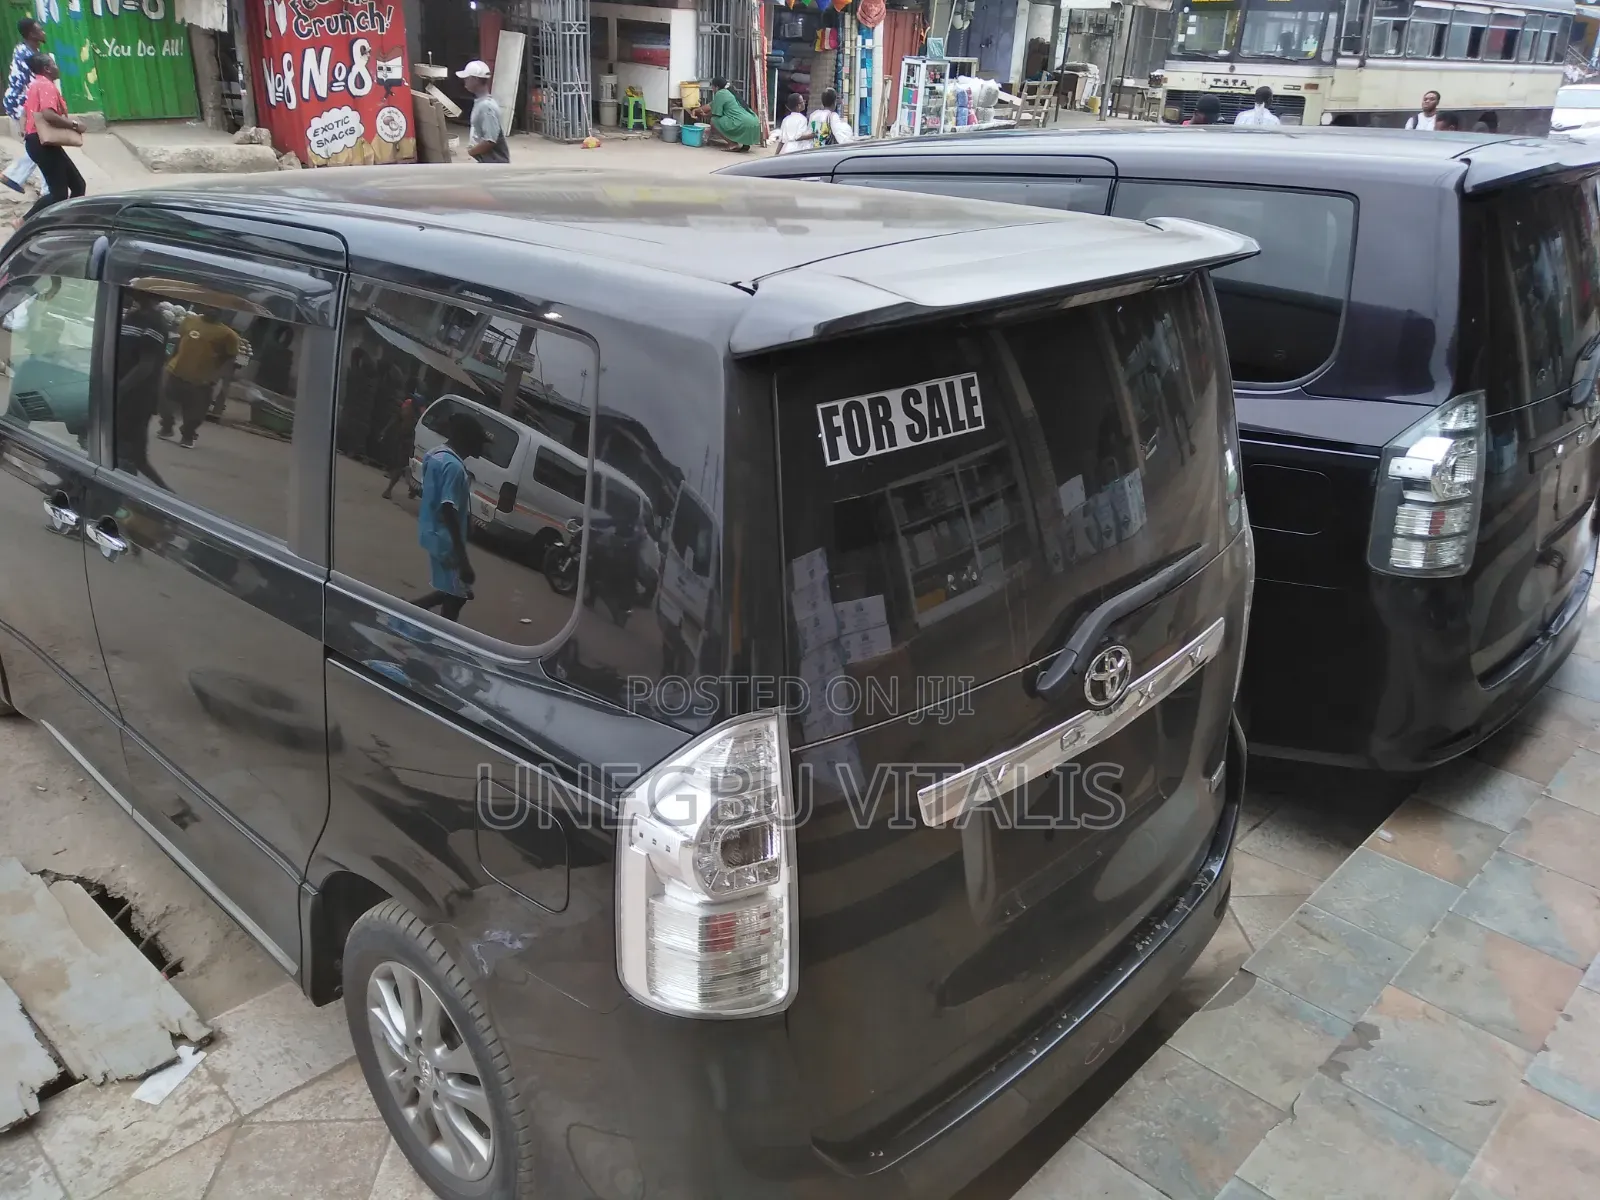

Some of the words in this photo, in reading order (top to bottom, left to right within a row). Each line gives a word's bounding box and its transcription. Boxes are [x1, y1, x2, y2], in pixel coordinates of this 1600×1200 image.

[293, 1, 394, 39] Crunch!
[137, 40, 156, 57] Do
[162, 37, 184, 57] All!
[313, 116, 350, 138] EXOTIC
[316, 127, 356, 148] SNACKS
[820, 395, 898, 462] FOR
[901, 376, 982, 443] SALE
